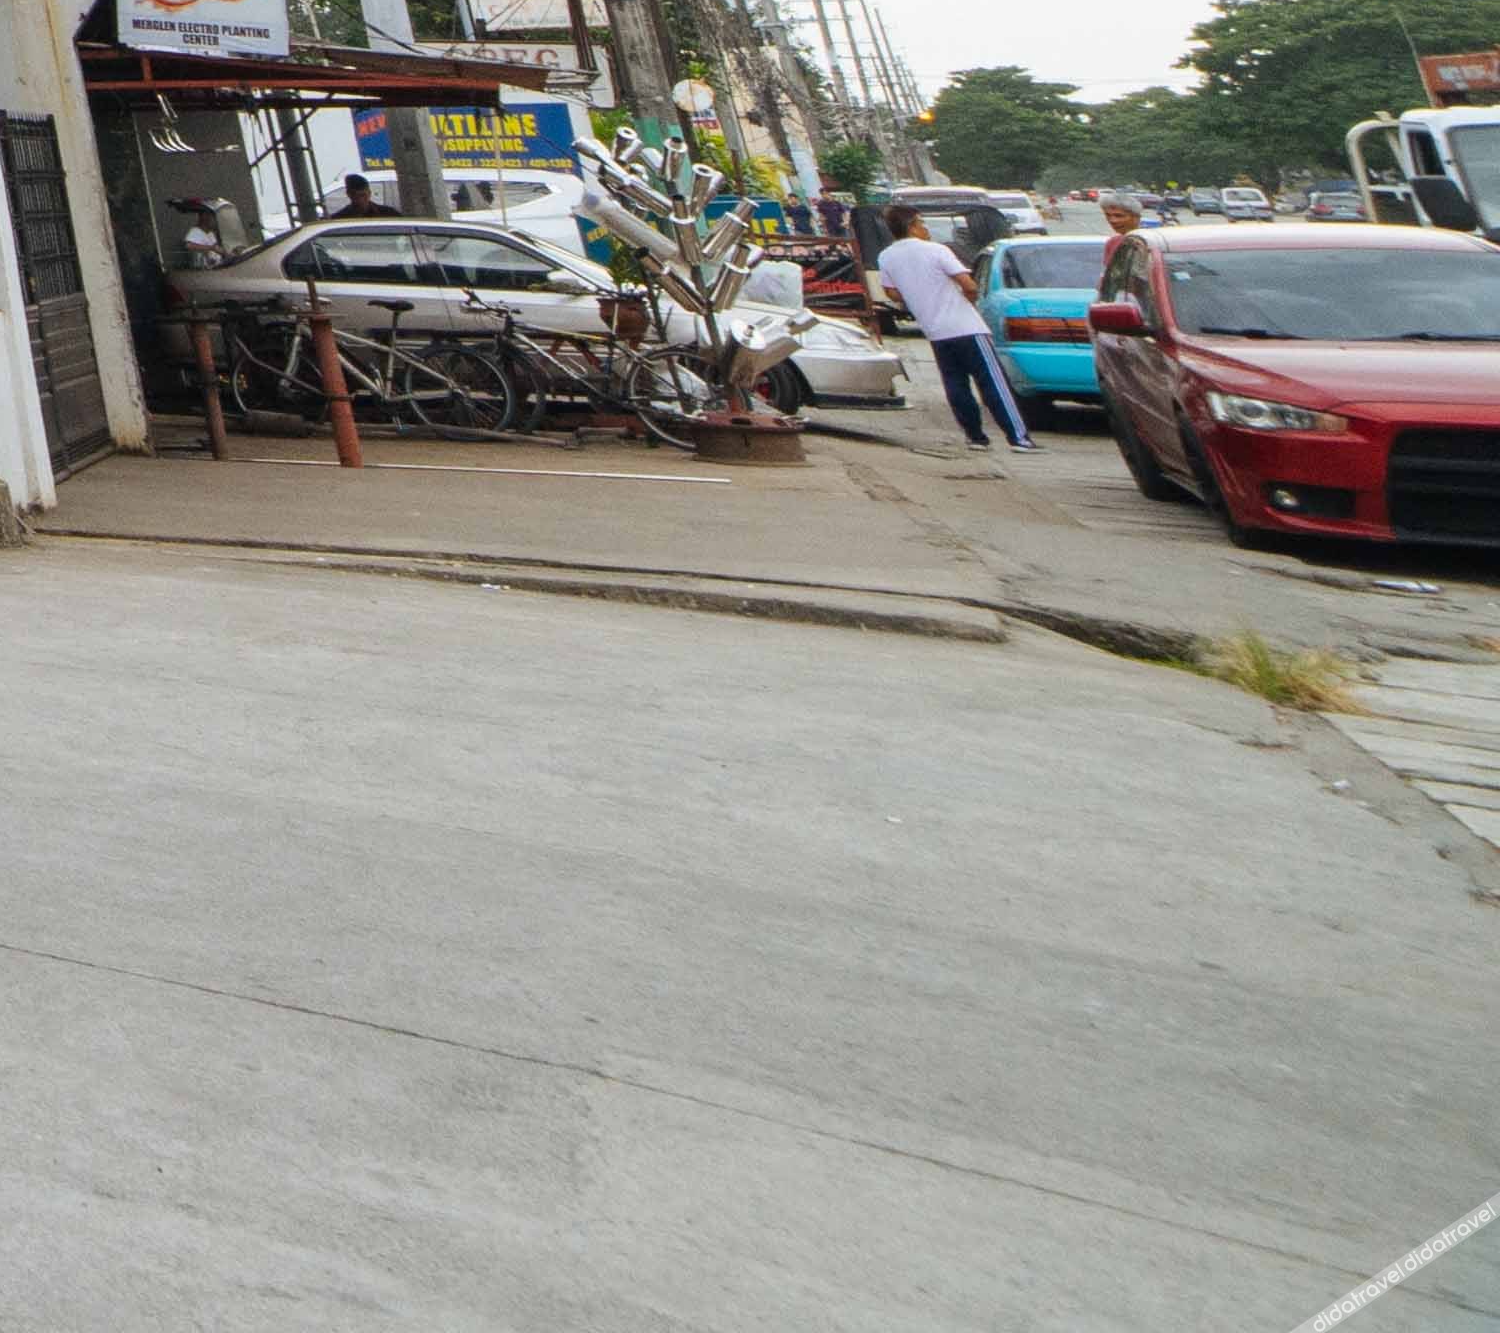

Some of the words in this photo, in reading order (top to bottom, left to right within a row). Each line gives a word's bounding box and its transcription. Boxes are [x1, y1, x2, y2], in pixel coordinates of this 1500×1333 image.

[178, 21, 220, 35] ELECTRO
[222, 25, 271, 39] PLANTING
[182, 33, 220, 46] CENTER
